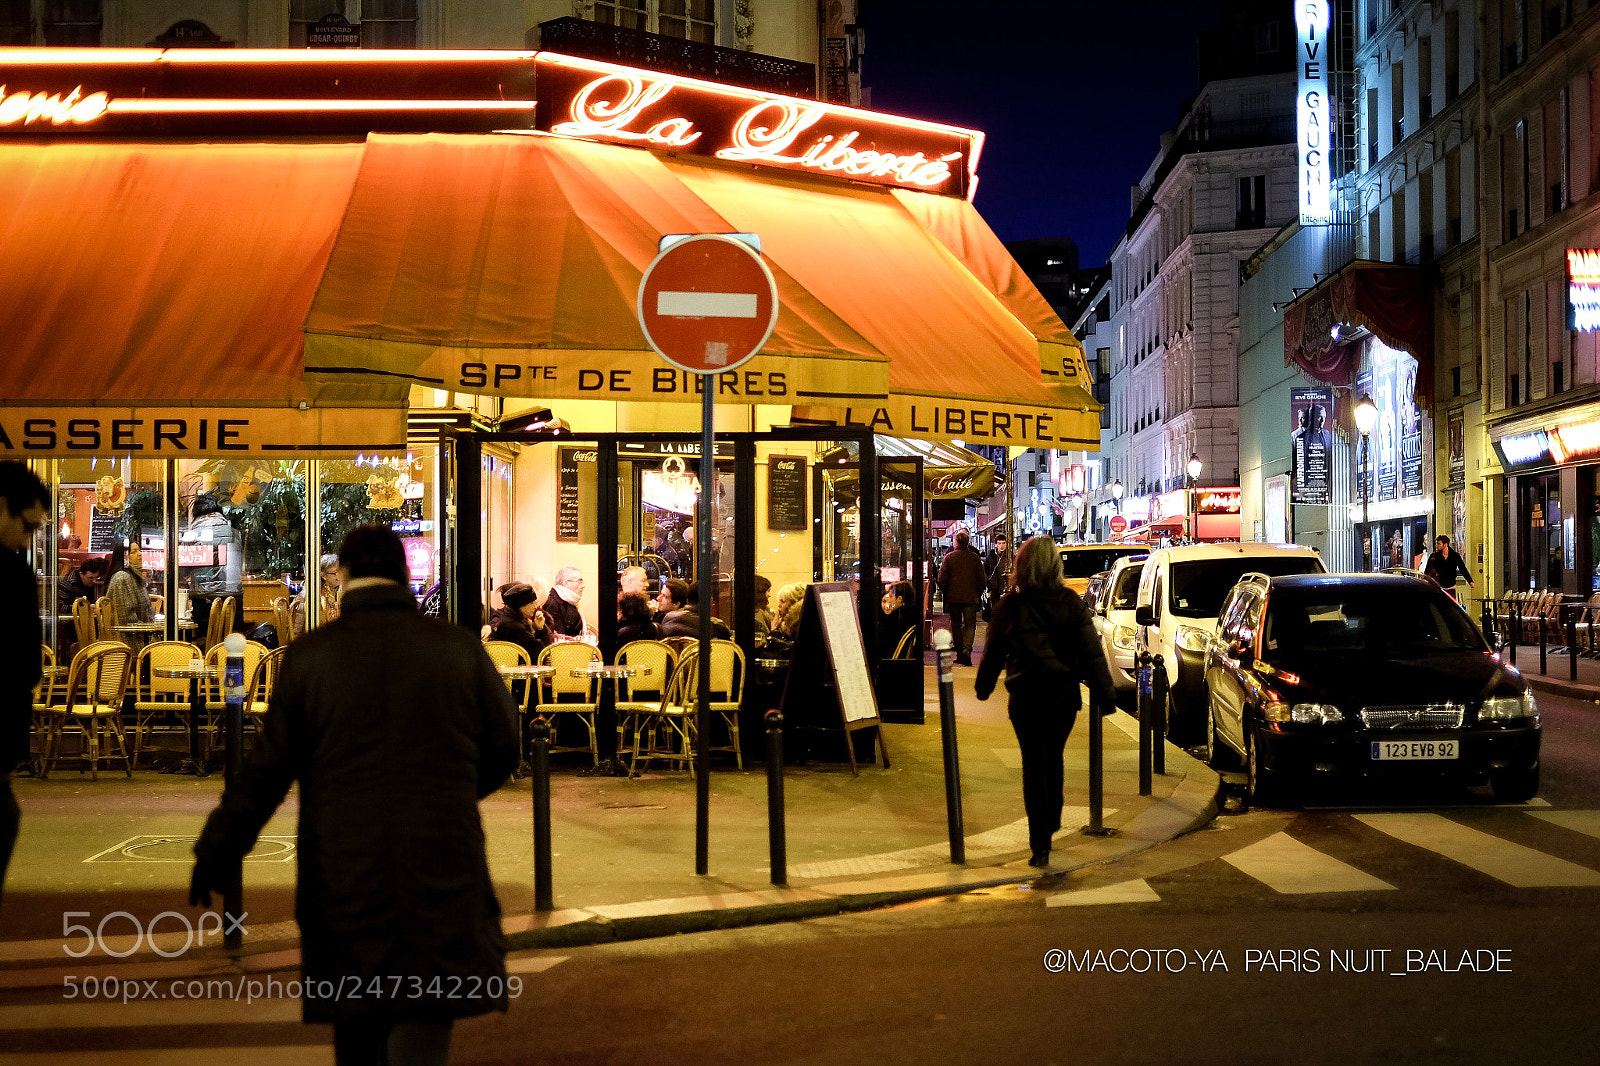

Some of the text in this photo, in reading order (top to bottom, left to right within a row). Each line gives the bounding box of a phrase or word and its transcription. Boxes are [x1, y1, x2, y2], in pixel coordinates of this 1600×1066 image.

[1304, 3, 1320, 80] RIVE
[551, 72, 965, 186] La Liberté
[578, 369, 632, 392] DE
[911, 404, 1054, 441] LIBERTÉ
[660, 442, 674, 453] LA
[929, 473, 974, 497] Gaité
[1386, 743, 1454, 757] 123 EVB 92
